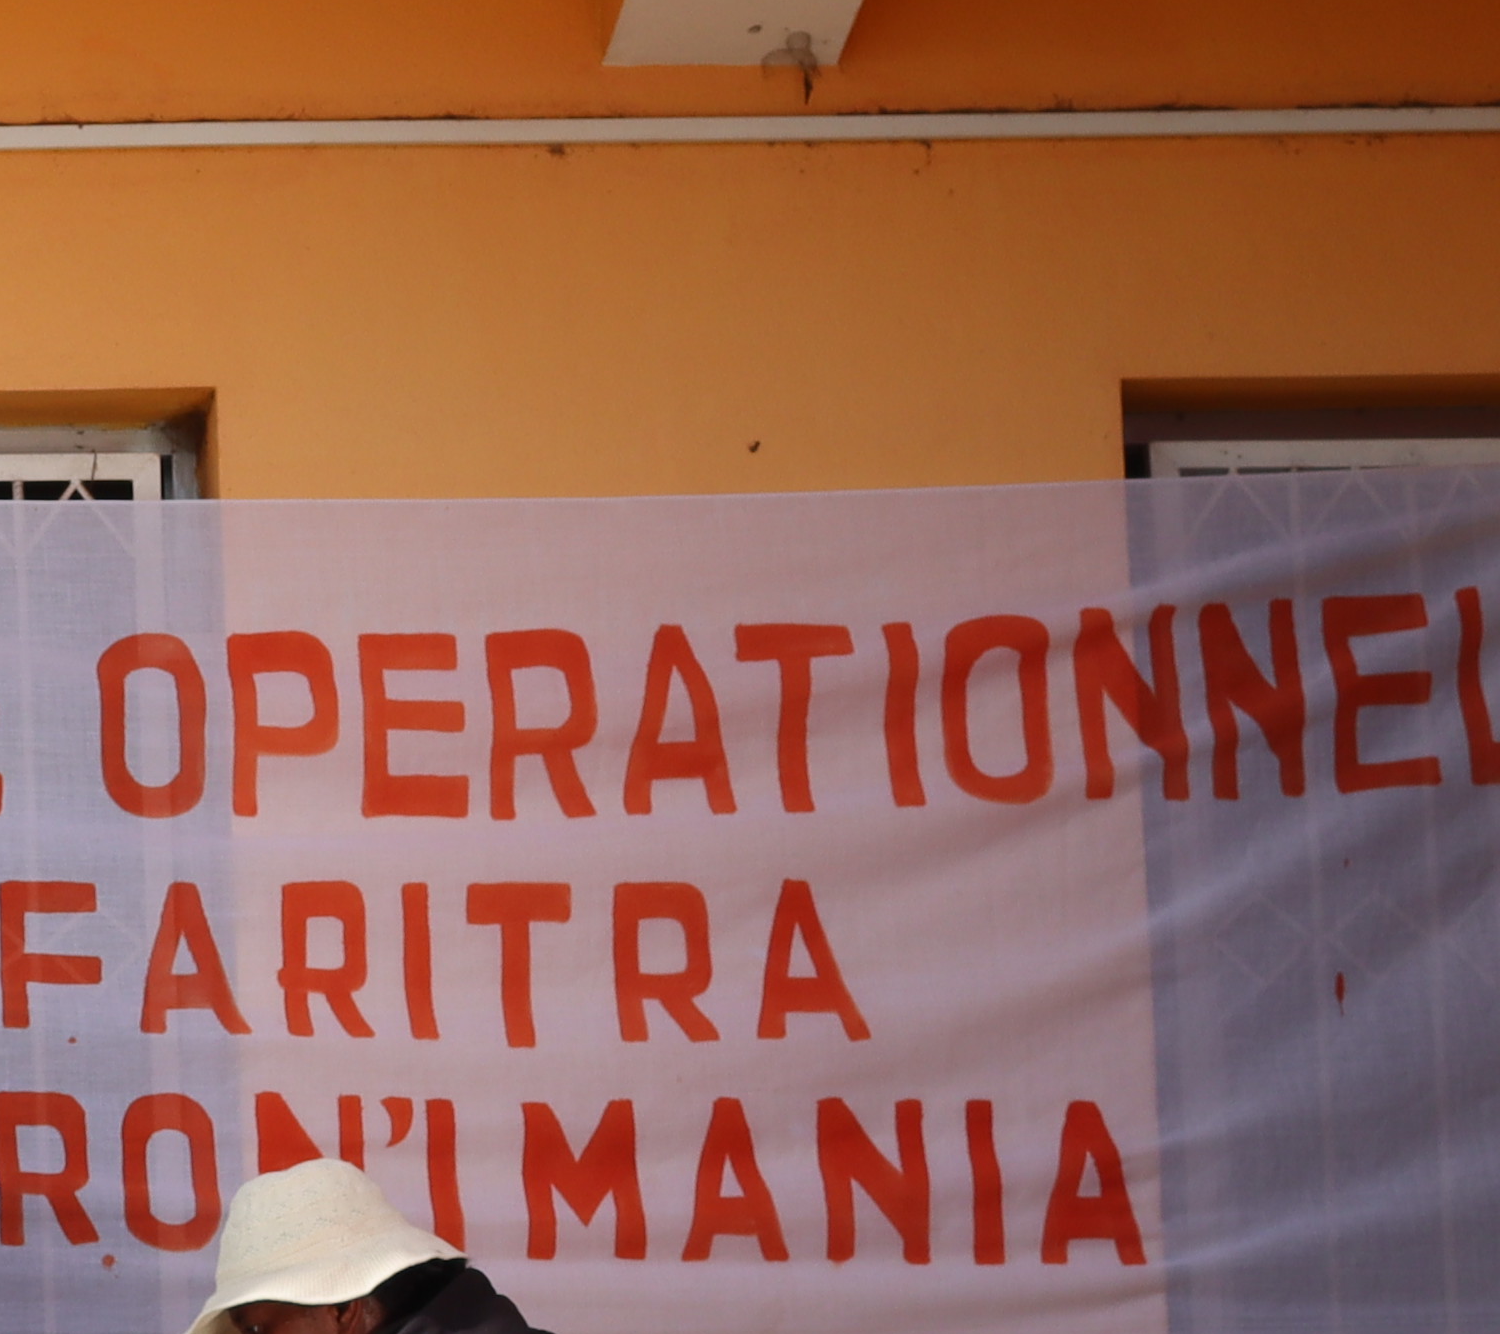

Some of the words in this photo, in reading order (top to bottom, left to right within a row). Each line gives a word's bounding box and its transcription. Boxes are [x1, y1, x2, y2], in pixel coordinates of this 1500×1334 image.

[97, 587, 1500, 822] OPERATIONNEL
[0, 878, 872, 1049] FARITRA
[520, 1096, 1148, 1266] MANIA
